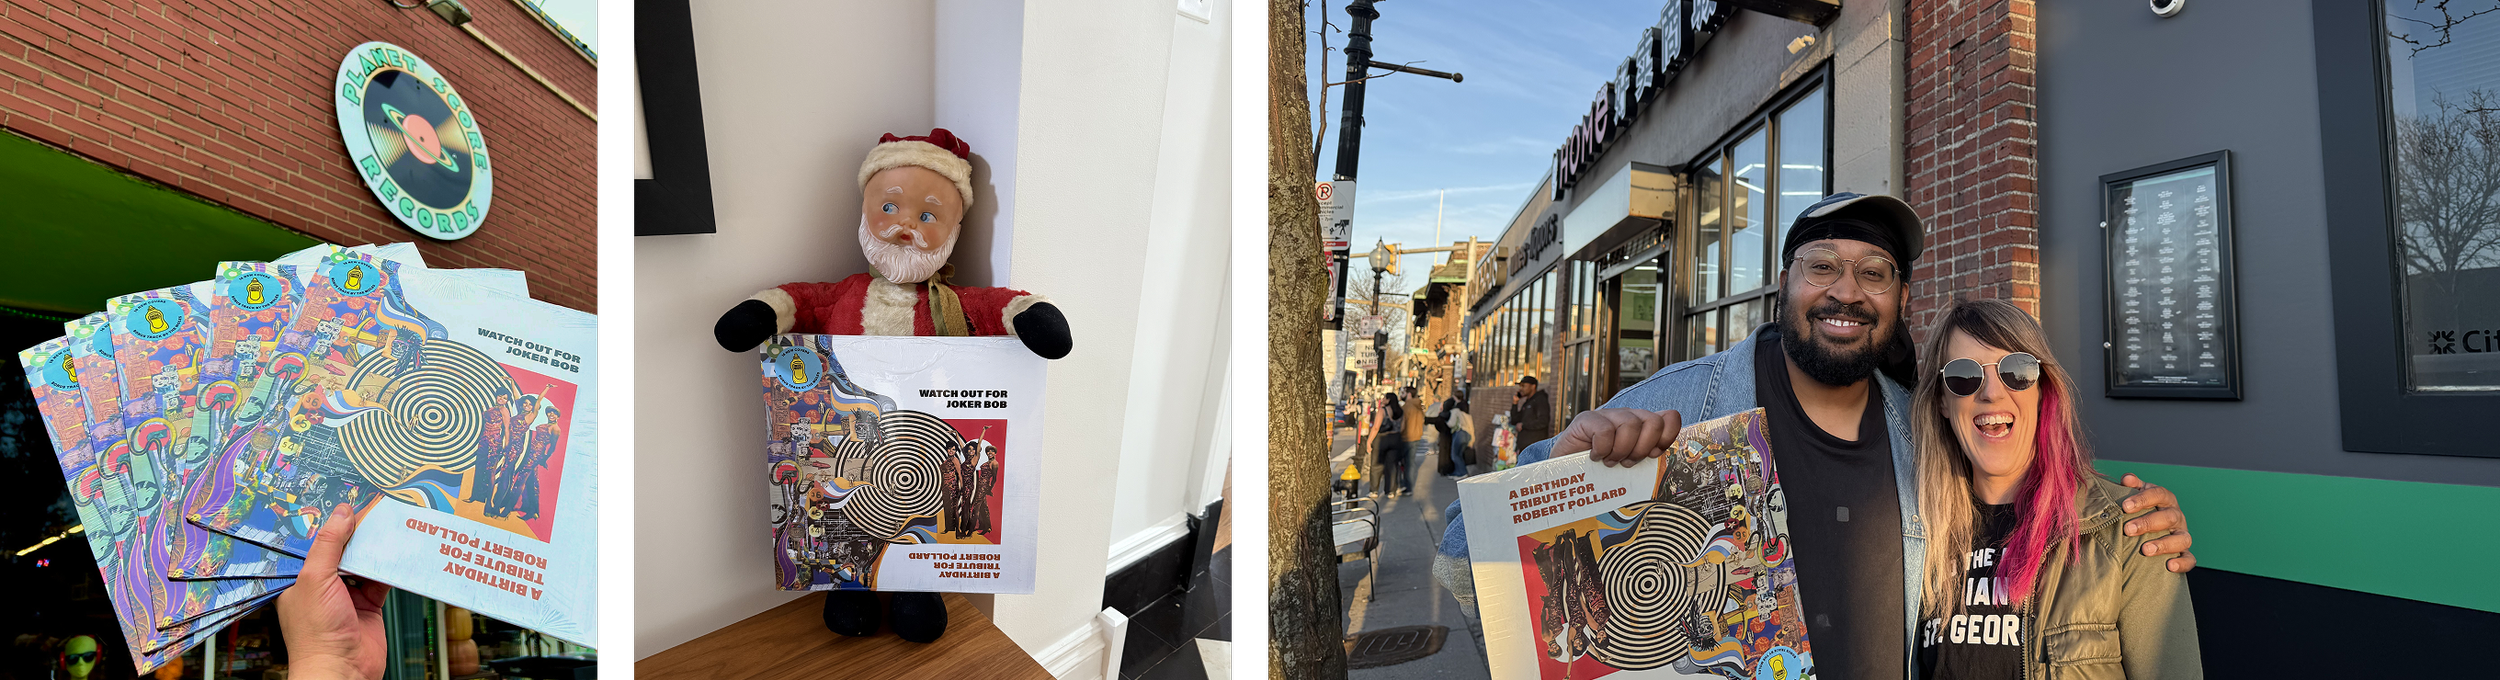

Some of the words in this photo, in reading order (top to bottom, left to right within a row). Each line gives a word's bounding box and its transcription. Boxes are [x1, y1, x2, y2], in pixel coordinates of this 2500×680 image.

[343, 48, 417, 106] PLANET
[431, 77, 488, 170] SCORE
[360, 154, 480, 233] RECORDS
[478, 327, 523, 347] WATCH
[525, 341, 553, 354] OUT
[553, 348, 581, 364] FOR
[506, 346, 548, 364] JOKER
[550, 357, 579, 373] BOB
[919, 389, 958, 398] WATCH
[960, 390, 984, 398] OUT
[985, 390, 1008, 398] FOR
[946, 400, 982, 408] JOKER
[983, 400, 1008, 409] BOB
[1509, 490, 1518, 500] A
[1520, 473, 1585, 497] BIRTHDAY
[1510, 490, 1567, 511] TRIBUTE
[1569, 483, 1595, 497] FOR
[1513, 503, 1565, 524] ROBERT
[1568, 487, 1627, 510] POLLARD
[406, 518, 480, 549] POLLARD
[439, 543, 473, 563] FOR
[482, 541, 547, 570] ROBERT
[909, 552, 957, 560] POLLARD
[956, 562, 1000, 570] TRIBUTE
[959, 553, 1001, 561] ROBERT
[1966, 548, 1995, 570] THE
[443, 561, 527, 597] BIRTHDAY
[474, 554, 544, 586] TRIBUTE
[531, 587, 543, 601] A
[1950, 614, 2025, 646] GEOR
